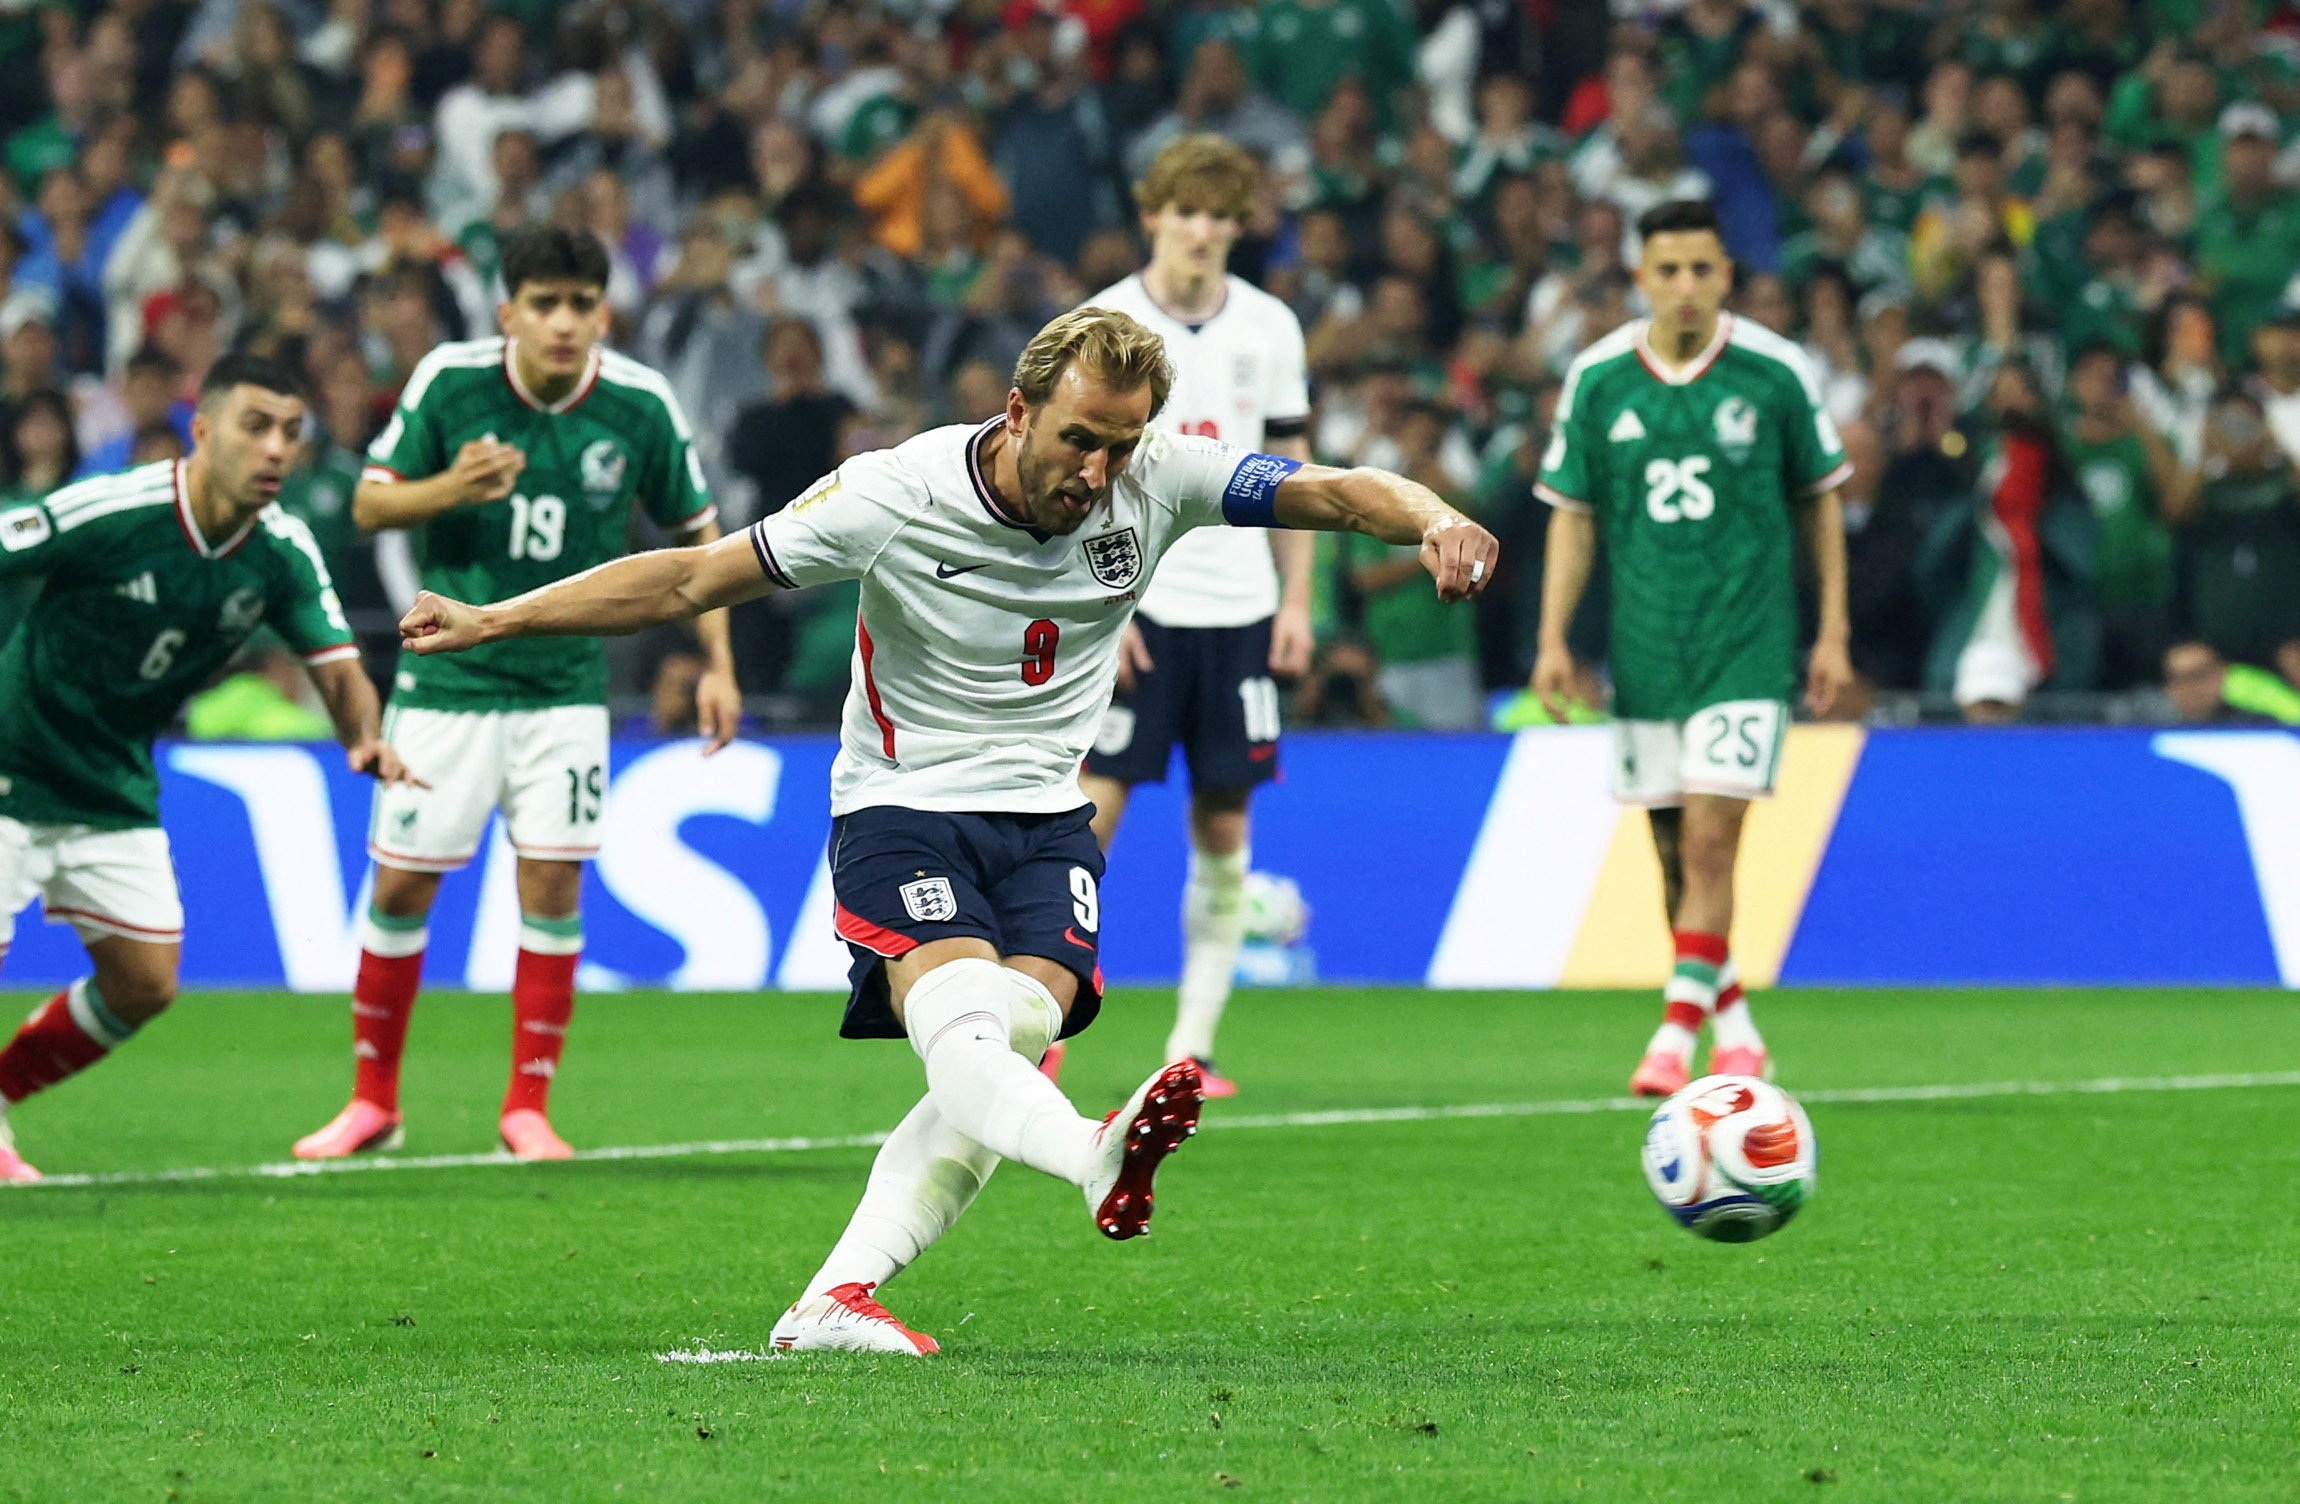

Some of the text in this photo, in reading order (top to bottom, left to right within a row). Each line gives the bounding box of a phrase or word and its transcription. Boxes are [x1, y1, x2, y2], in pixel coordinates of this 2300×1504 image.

[1229, 457, 1262, 496] FOOTBALL
[1239, 459, 1275, 498] UNITES
[1252, 481, 1266, 501] the
[1645, 455, 1716, 523] 25
[509, 493, 566, 561] 19
[139, 628, 186, 679] 6
[1021, 618, 1059, 687] 9
[1706, 714, 1761, 767] 25
[1069, 866, 1099, 932] 9
